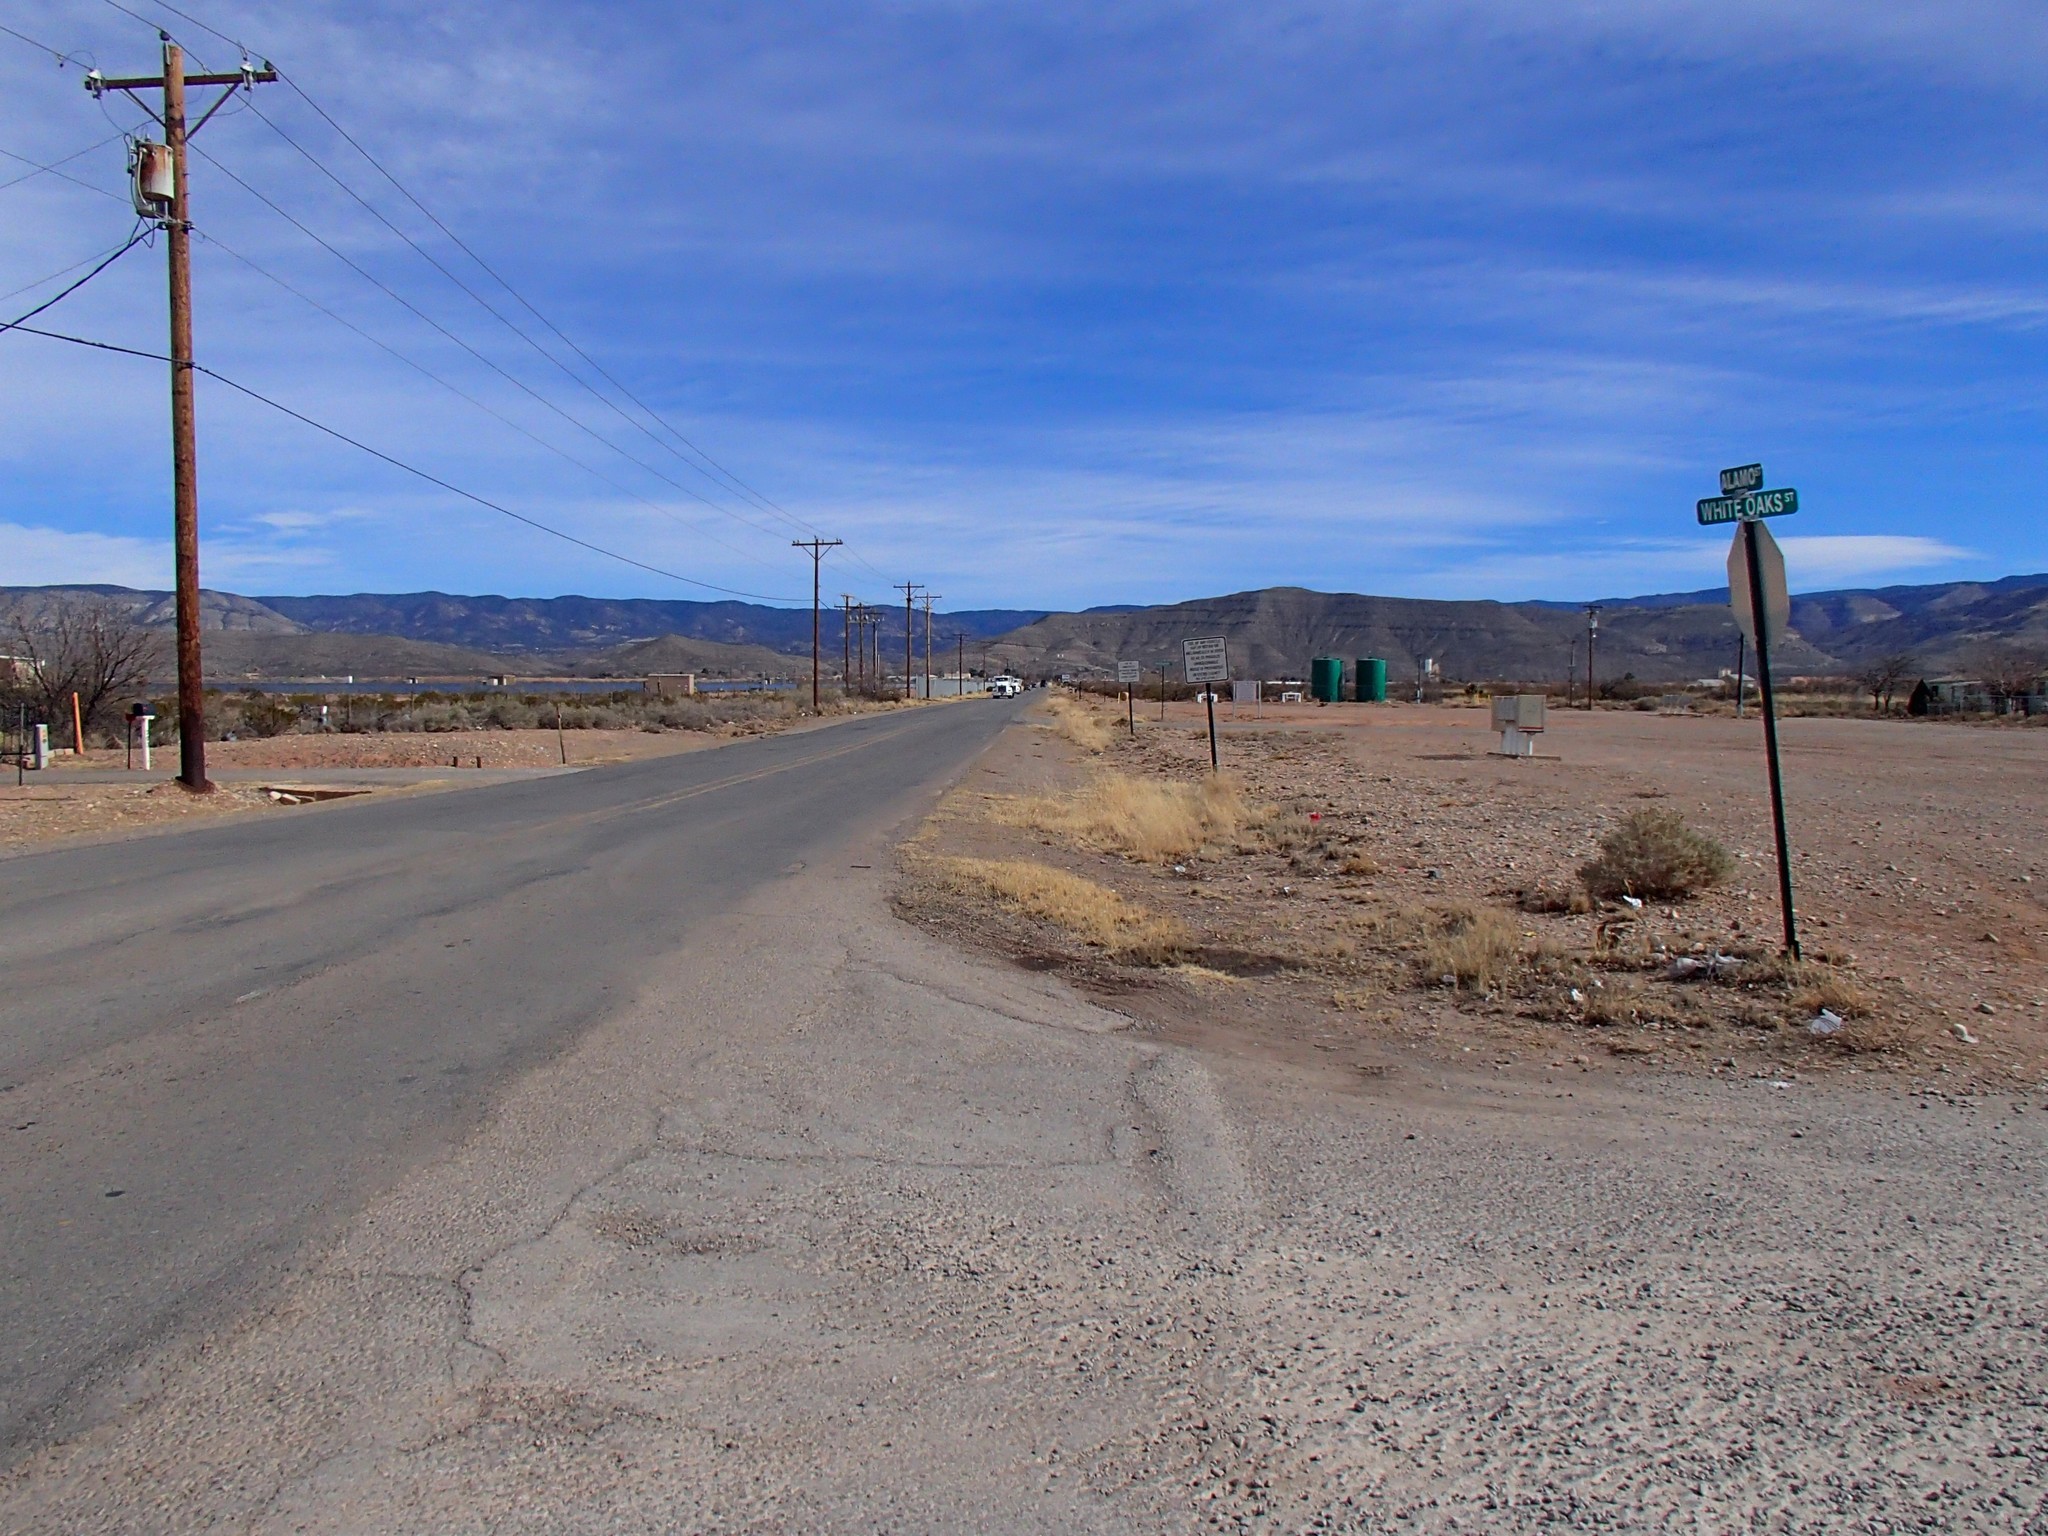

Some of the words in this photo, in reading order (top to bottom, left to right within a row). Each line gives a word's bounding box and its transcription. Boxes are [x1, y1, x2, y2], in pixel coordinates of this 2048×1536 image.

[1721, 468, 1756, 490] ALAMO
[1701, 499, 1743, 521] WHITE
[1746, 493, 1783, 515] OAKS
[1784, 492, 1794, 503] ST
